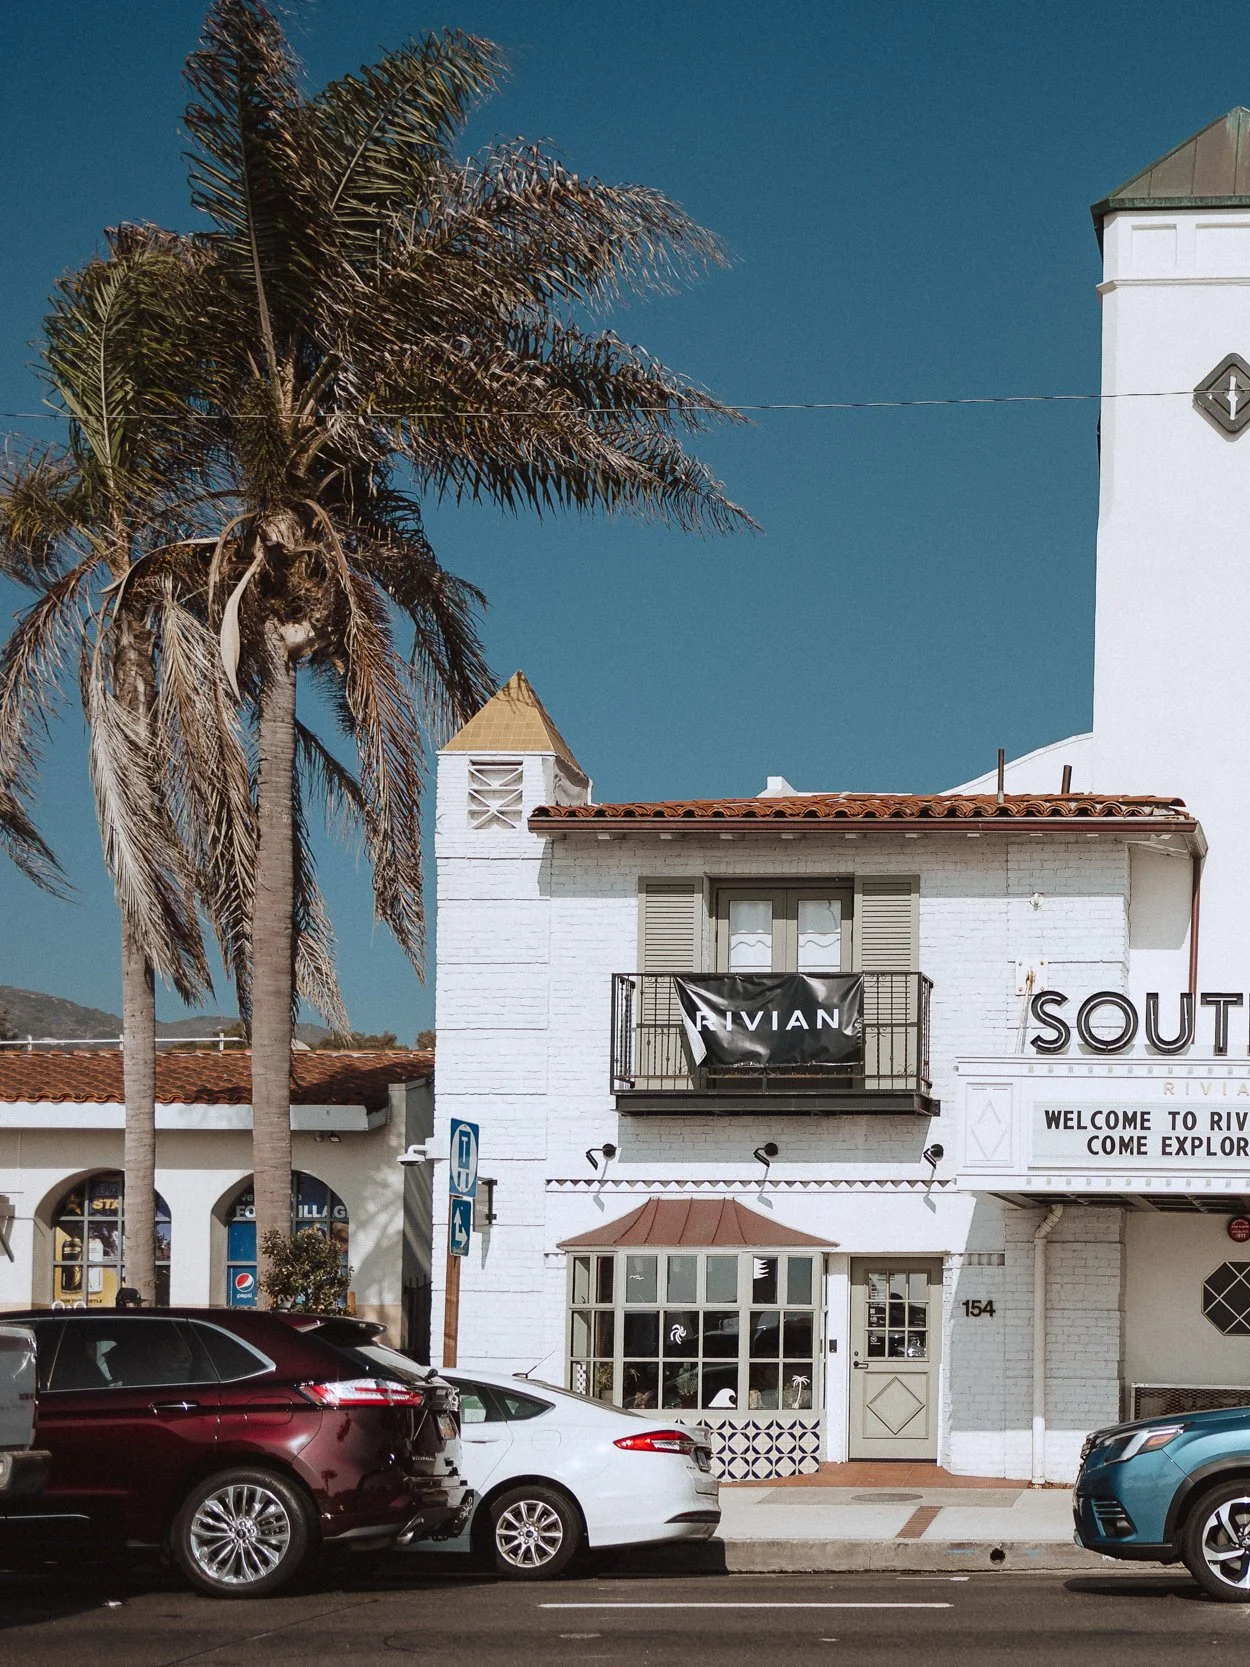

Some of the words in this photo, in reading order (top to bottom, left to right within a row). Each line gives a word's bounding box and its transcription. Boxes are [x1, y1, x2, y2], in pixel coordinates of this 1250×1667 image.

[695, 1008, 840, 1031] RIVIAN
[1044, 1109, 1151, 1131] WELCOME
[1168, 1111, 1197, 1131] TO
[1086, 1135, 1148, 1156] COME
[961, 1300, 996, 1317] 154
